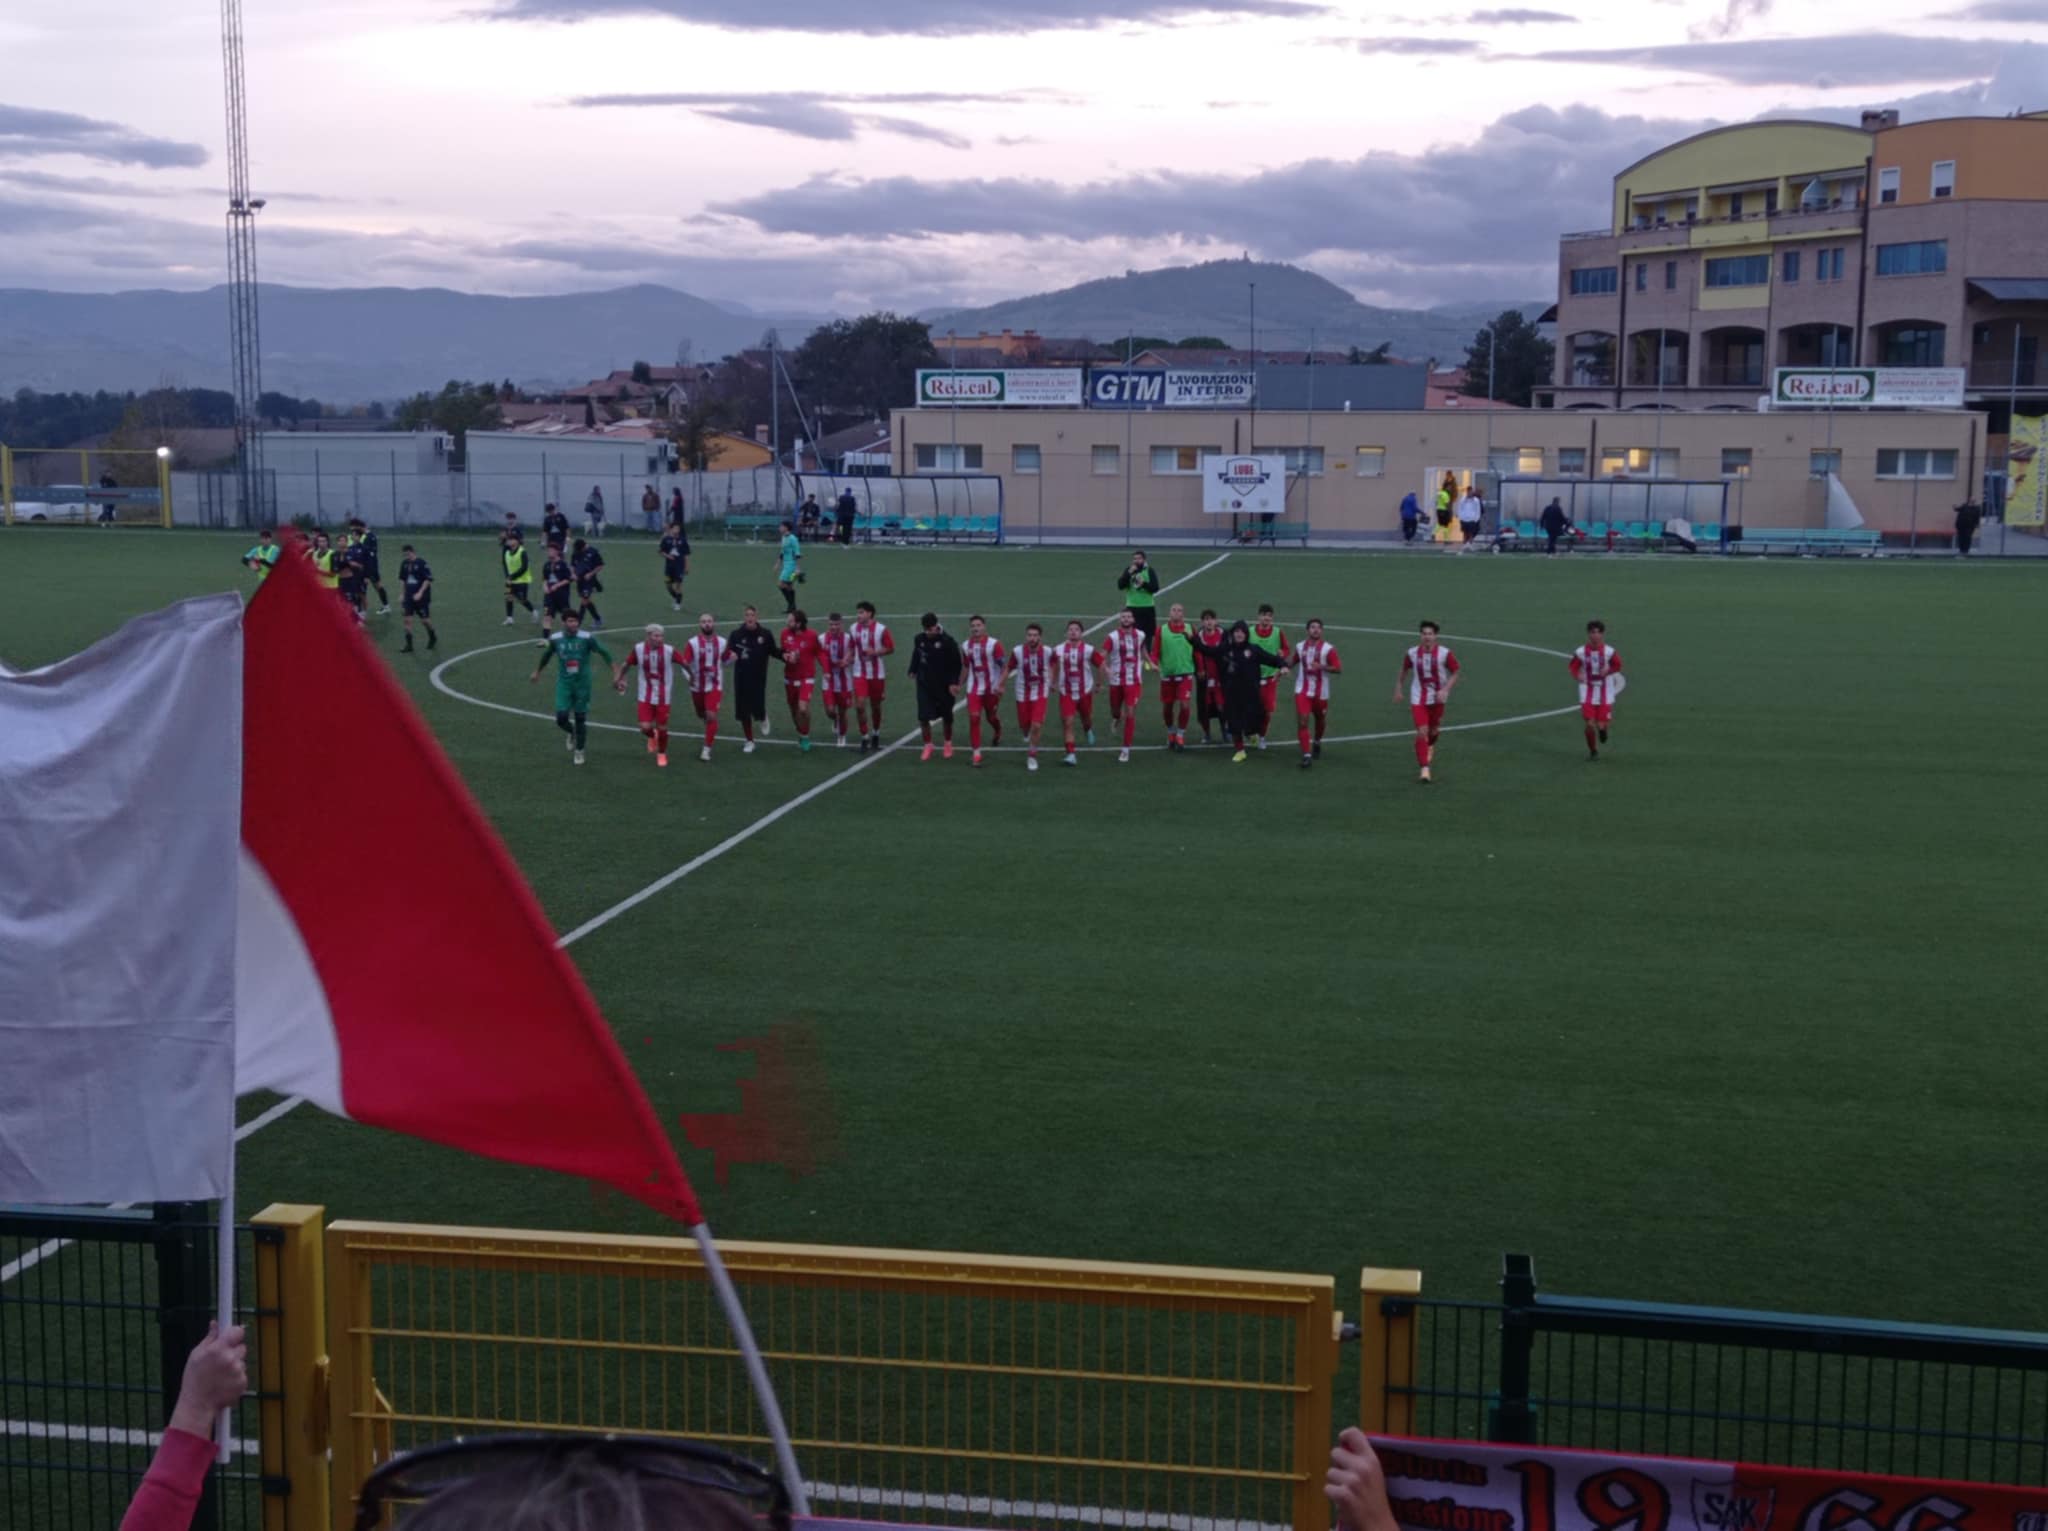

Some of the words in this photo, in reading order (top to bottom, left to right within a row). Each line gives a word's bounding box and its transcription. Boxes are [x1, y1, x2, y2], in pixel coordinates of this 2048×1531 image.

[931, 379, 997, 395] Re.i.cal.
[1096, 374, 1163, 401] GTM
[1168, 375, 1253, 385] LAVORAZIONI
[1790, 378, 1864, 394] Re.i.cal.
[1178, 385, 1193, 395] IN
[1197, 385, 1244, 395] FERRO
